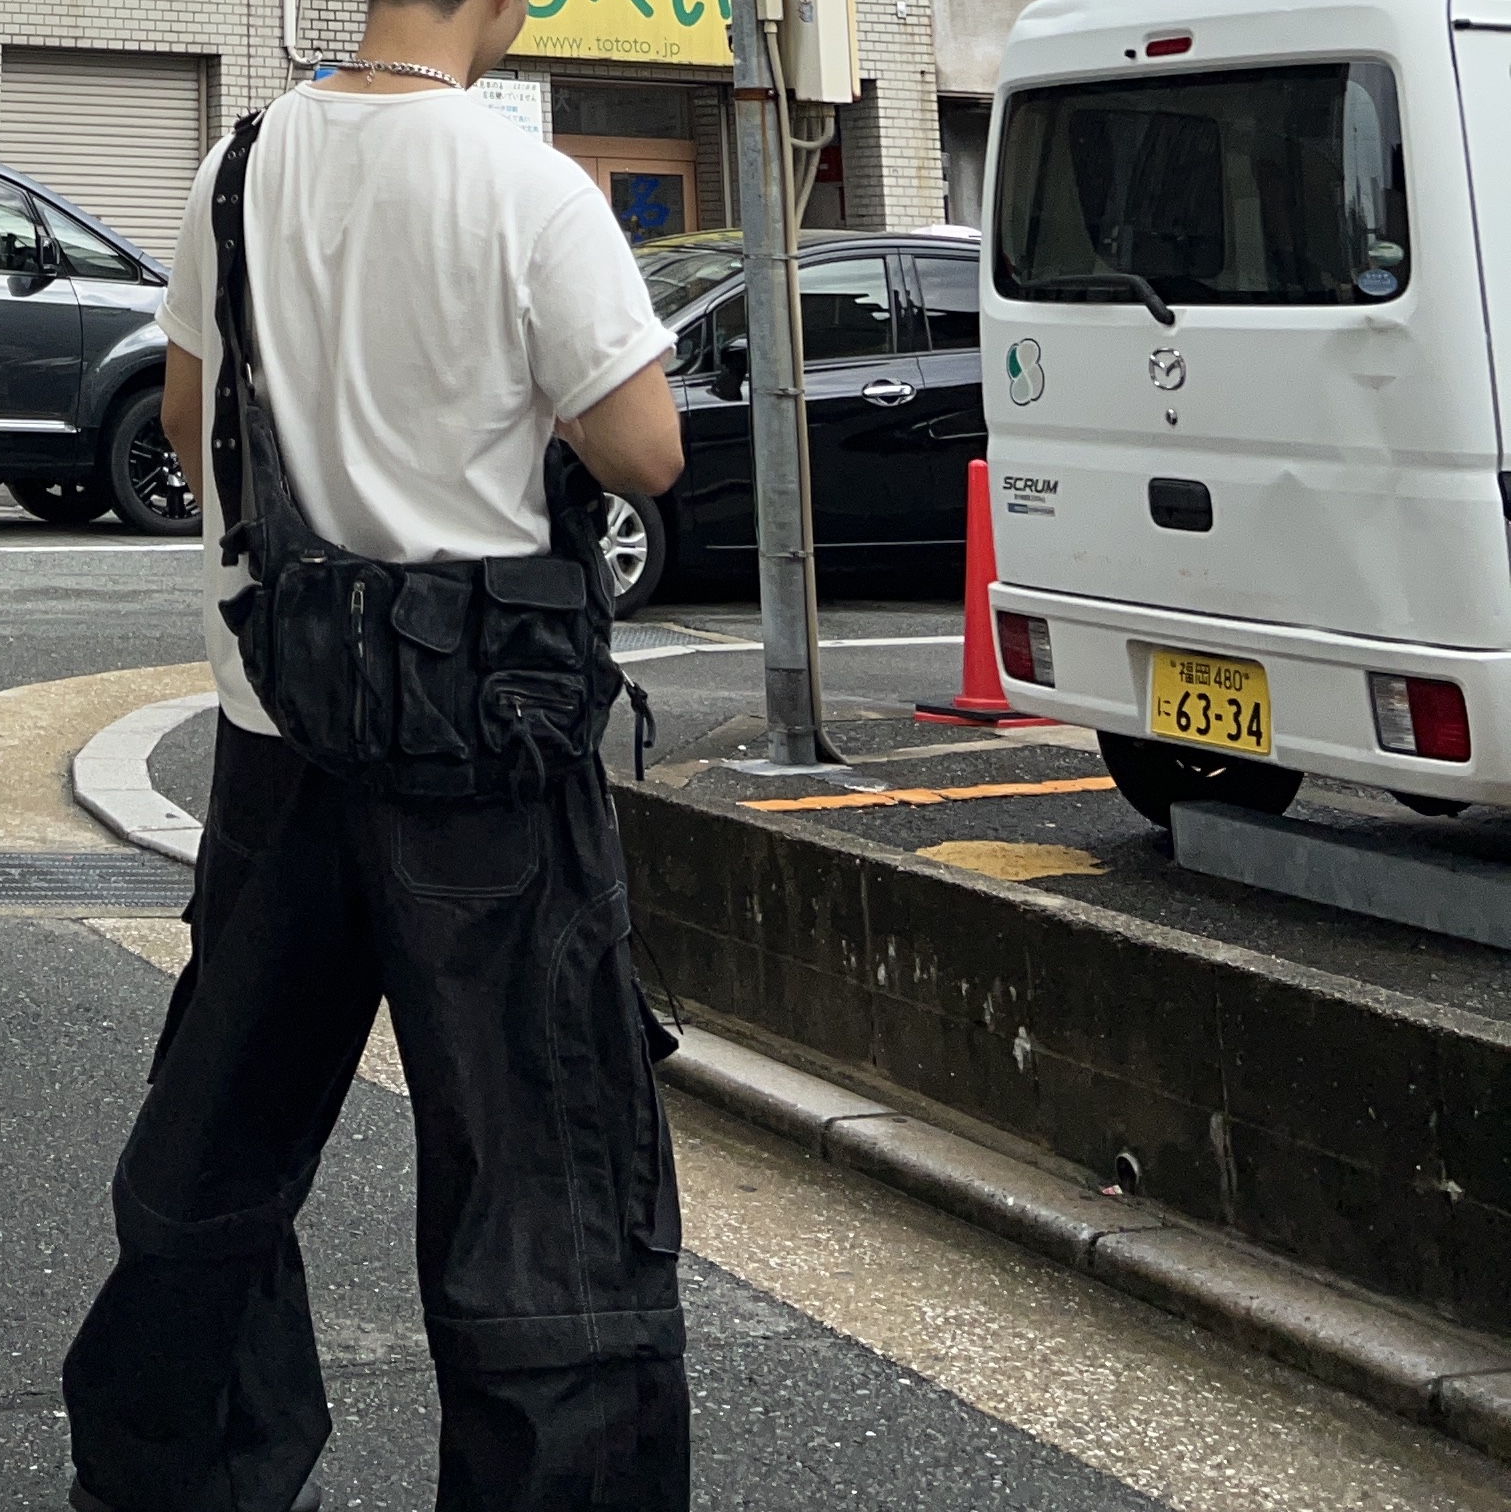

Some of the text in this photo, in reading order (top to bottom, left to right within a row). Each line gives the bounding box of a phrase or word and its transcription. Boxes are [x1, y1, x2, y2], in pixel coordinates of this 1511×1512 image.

[1003, 475, 1059, 495] SCRUM
[1178, 661, 1244, 692] 福岡 480
[1157, 690, 1264, 747] に 63-34
